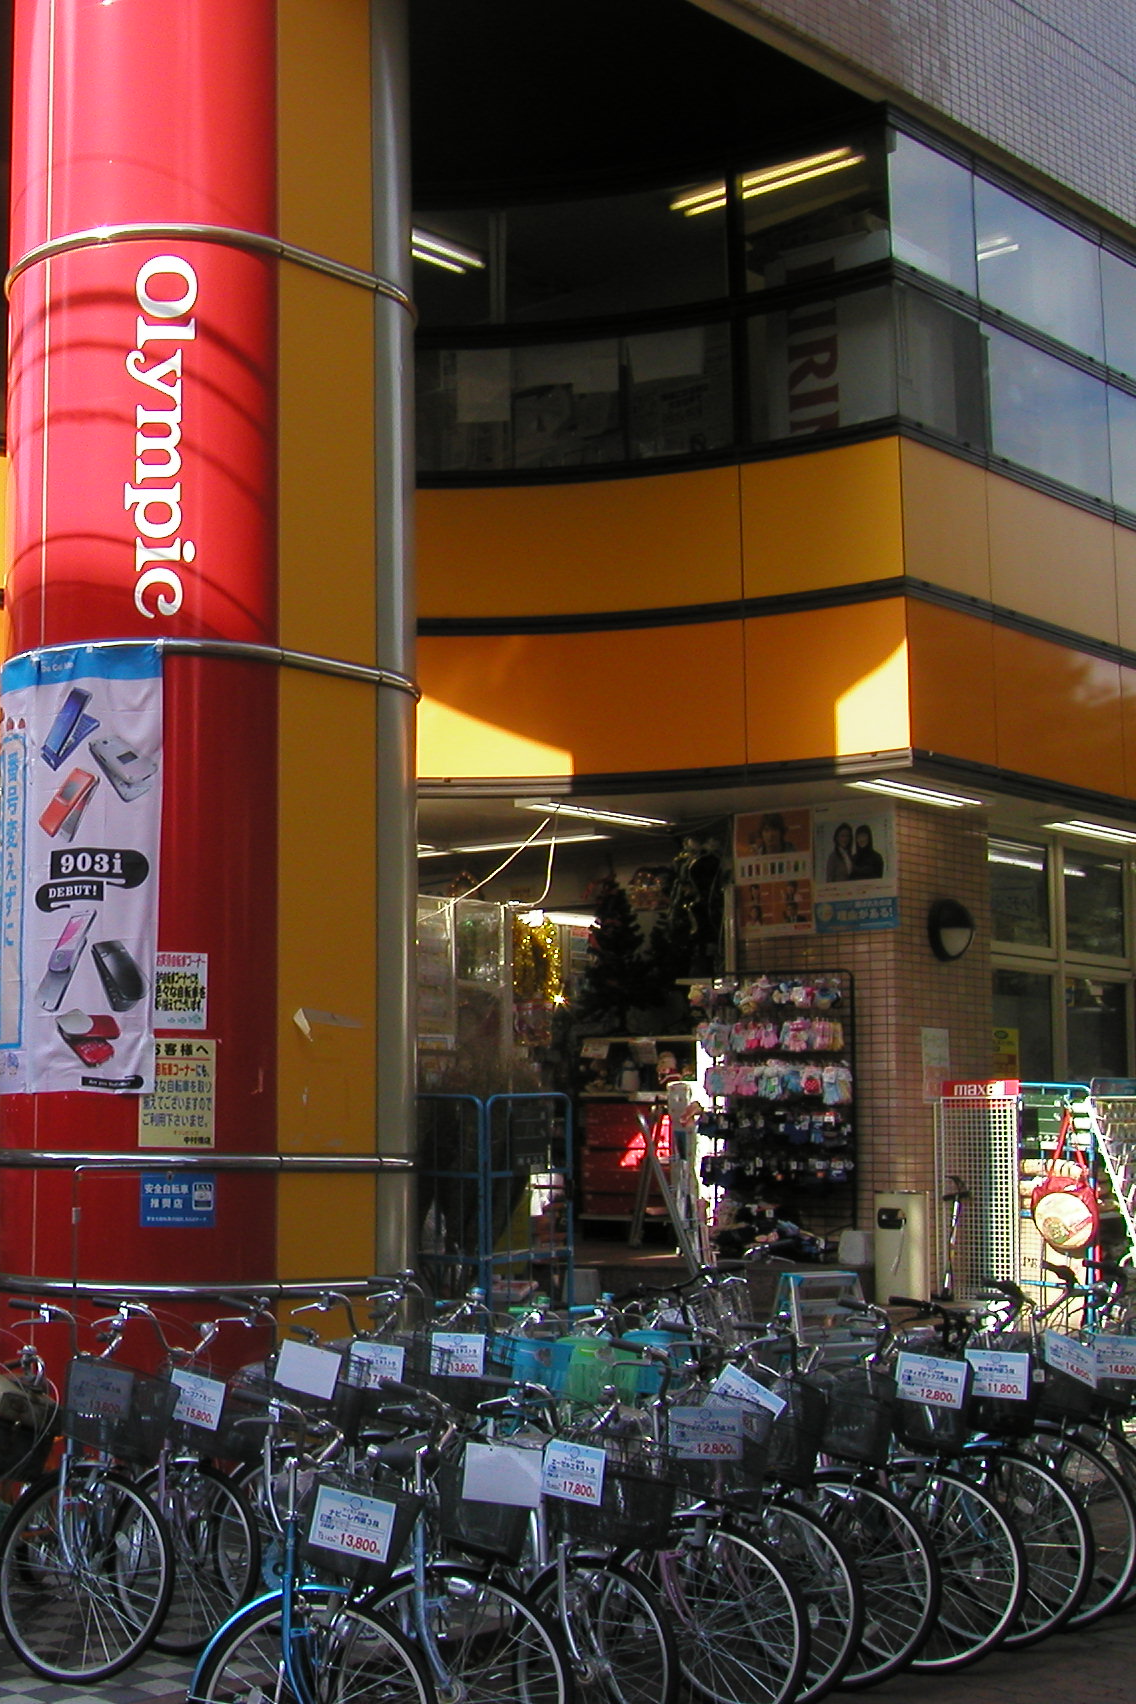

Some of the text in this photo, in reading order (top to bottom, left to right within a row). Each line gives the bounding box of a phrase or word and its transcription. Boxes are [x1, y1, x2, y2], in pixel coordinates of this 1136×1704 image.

[124, 254, 198, 618] Olympic
[60, 852, 123, 875] 903i
[48, 885, 97, 899] DEBUT!
[954, 1082, 996, 1096] maxe
